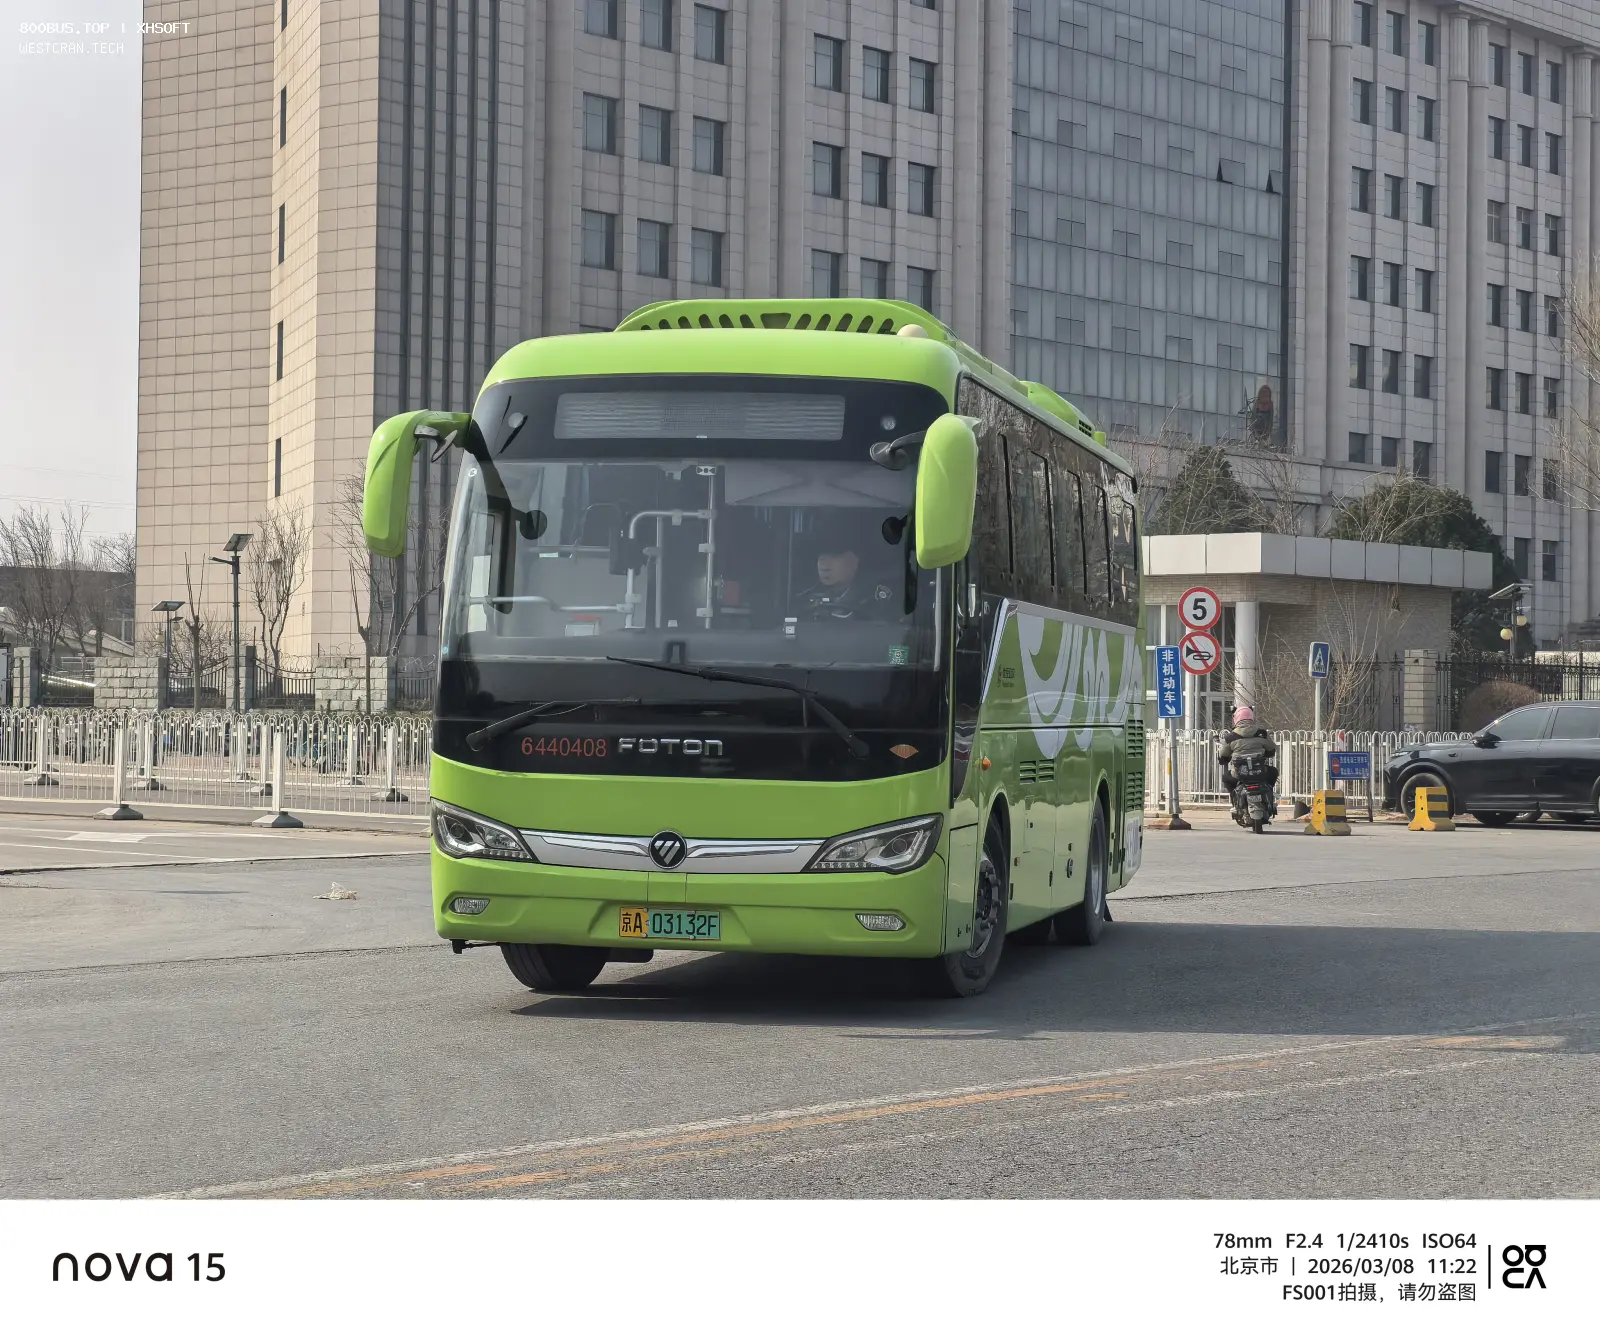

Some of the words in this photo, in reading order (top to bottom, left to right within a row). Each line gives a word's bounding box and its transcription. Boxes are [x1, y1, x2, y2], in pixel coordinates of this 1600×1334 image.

[1191, 597, 1208, 621] 5
[1161, 649, 1176, 704] 非机动车
[520, 737, 608, 758] 6440408
[617, 737, 724, 756] FOTON
